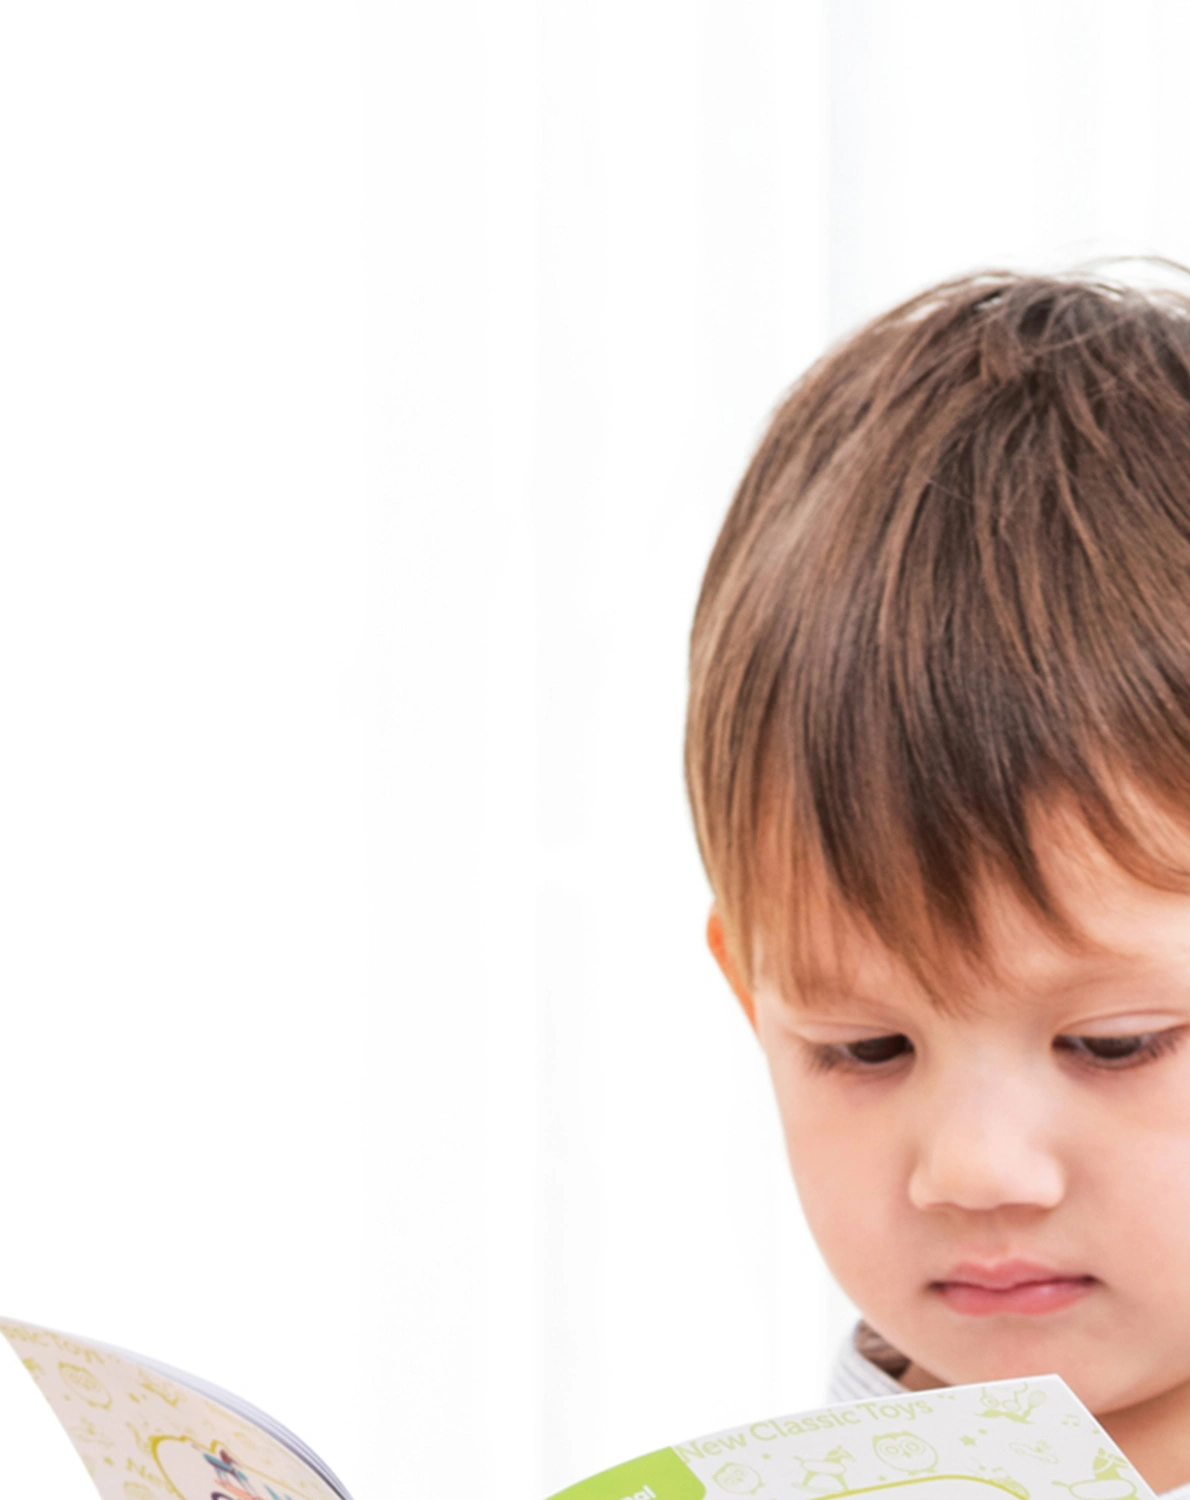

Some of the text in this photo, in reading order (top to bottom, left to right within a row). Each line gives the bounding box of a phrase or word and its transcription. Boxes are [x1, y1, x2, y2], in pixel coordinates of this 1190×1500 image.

[675, 1399, 934, 1464] New Classic Toys
